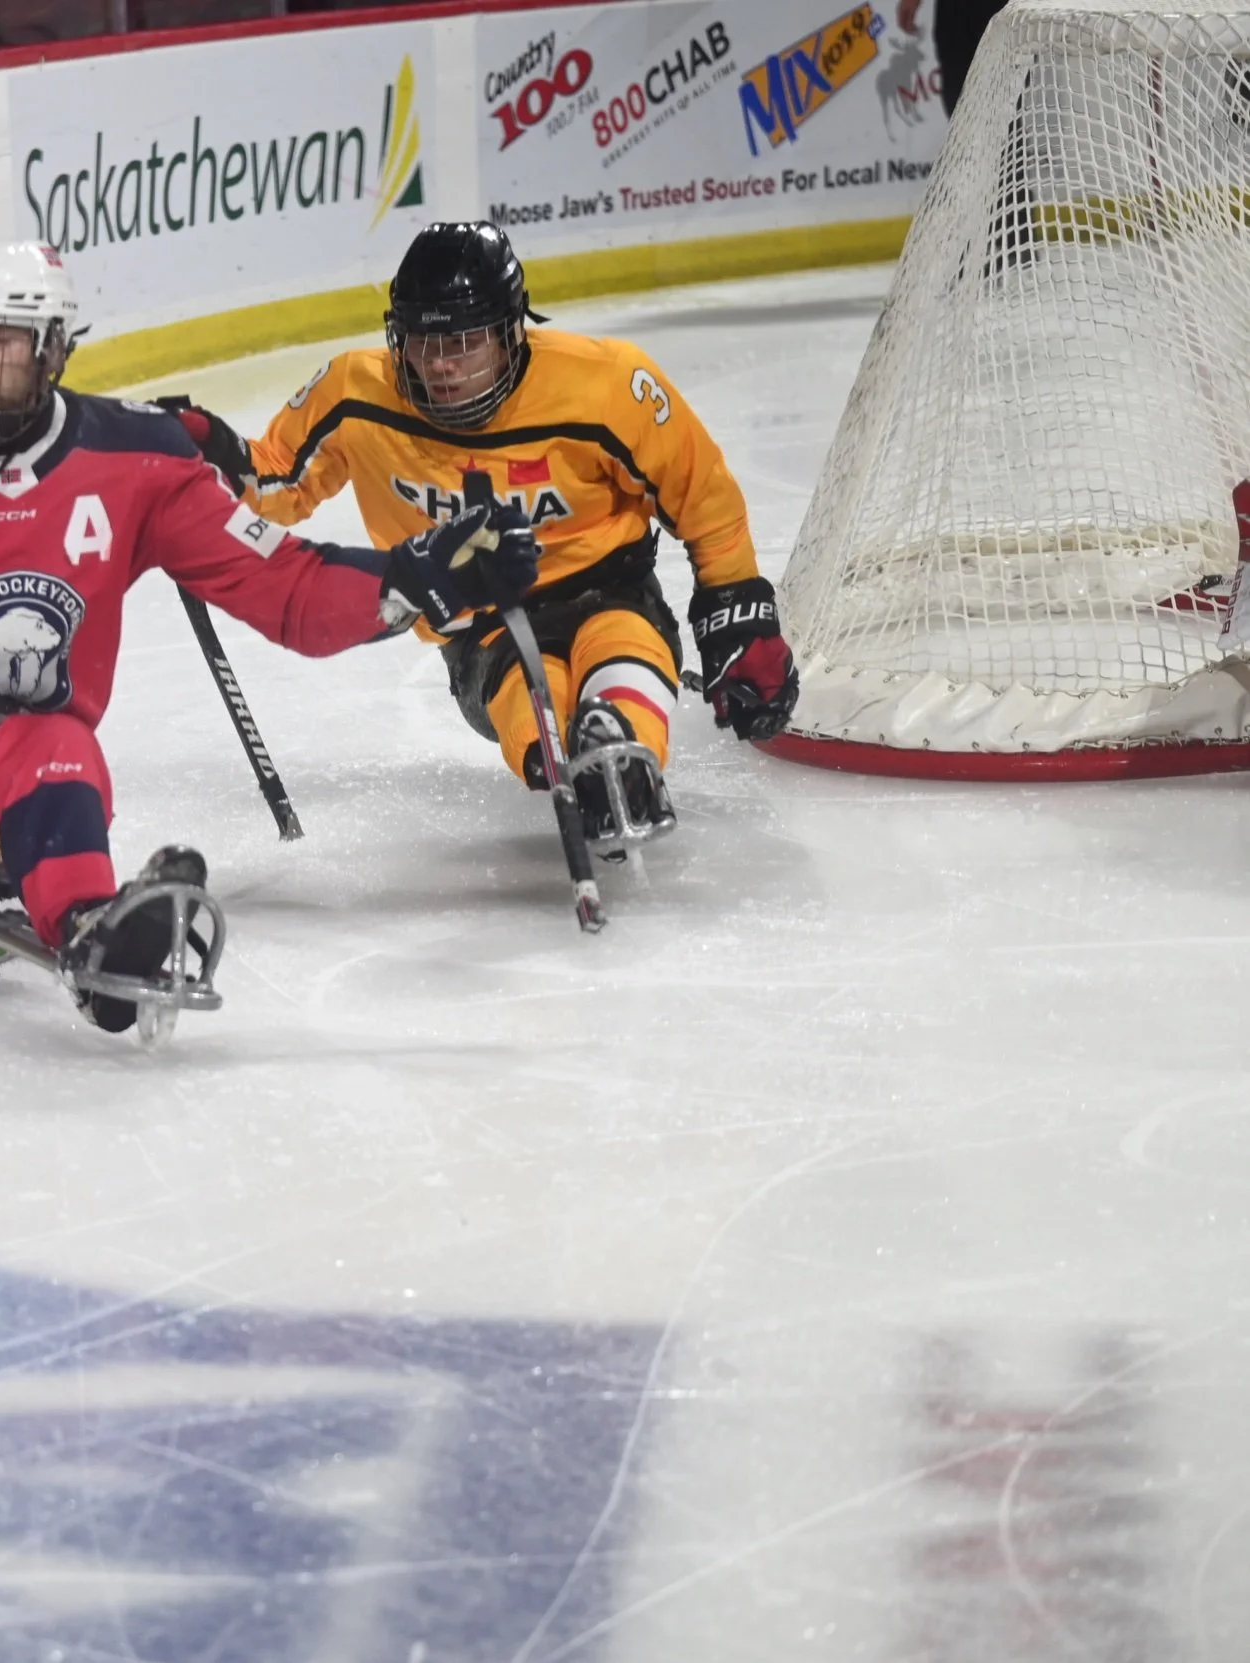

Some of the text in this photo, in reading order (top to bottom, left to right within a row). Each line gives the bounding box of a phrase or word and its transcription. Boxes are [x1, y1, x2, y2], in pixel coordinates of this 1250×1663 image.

[483, 30, 555, 103] Country
[489, 48, 593, 152] 100
[738, 31, 832, 157] MIX
[24, 116, 366, 253] Saskatchewan
[489, 157, 932, 228] Moose Jaw's Trusted Source For Local New
[630, 368, 670, 425] 3
[63, 494, 113, 566] A
